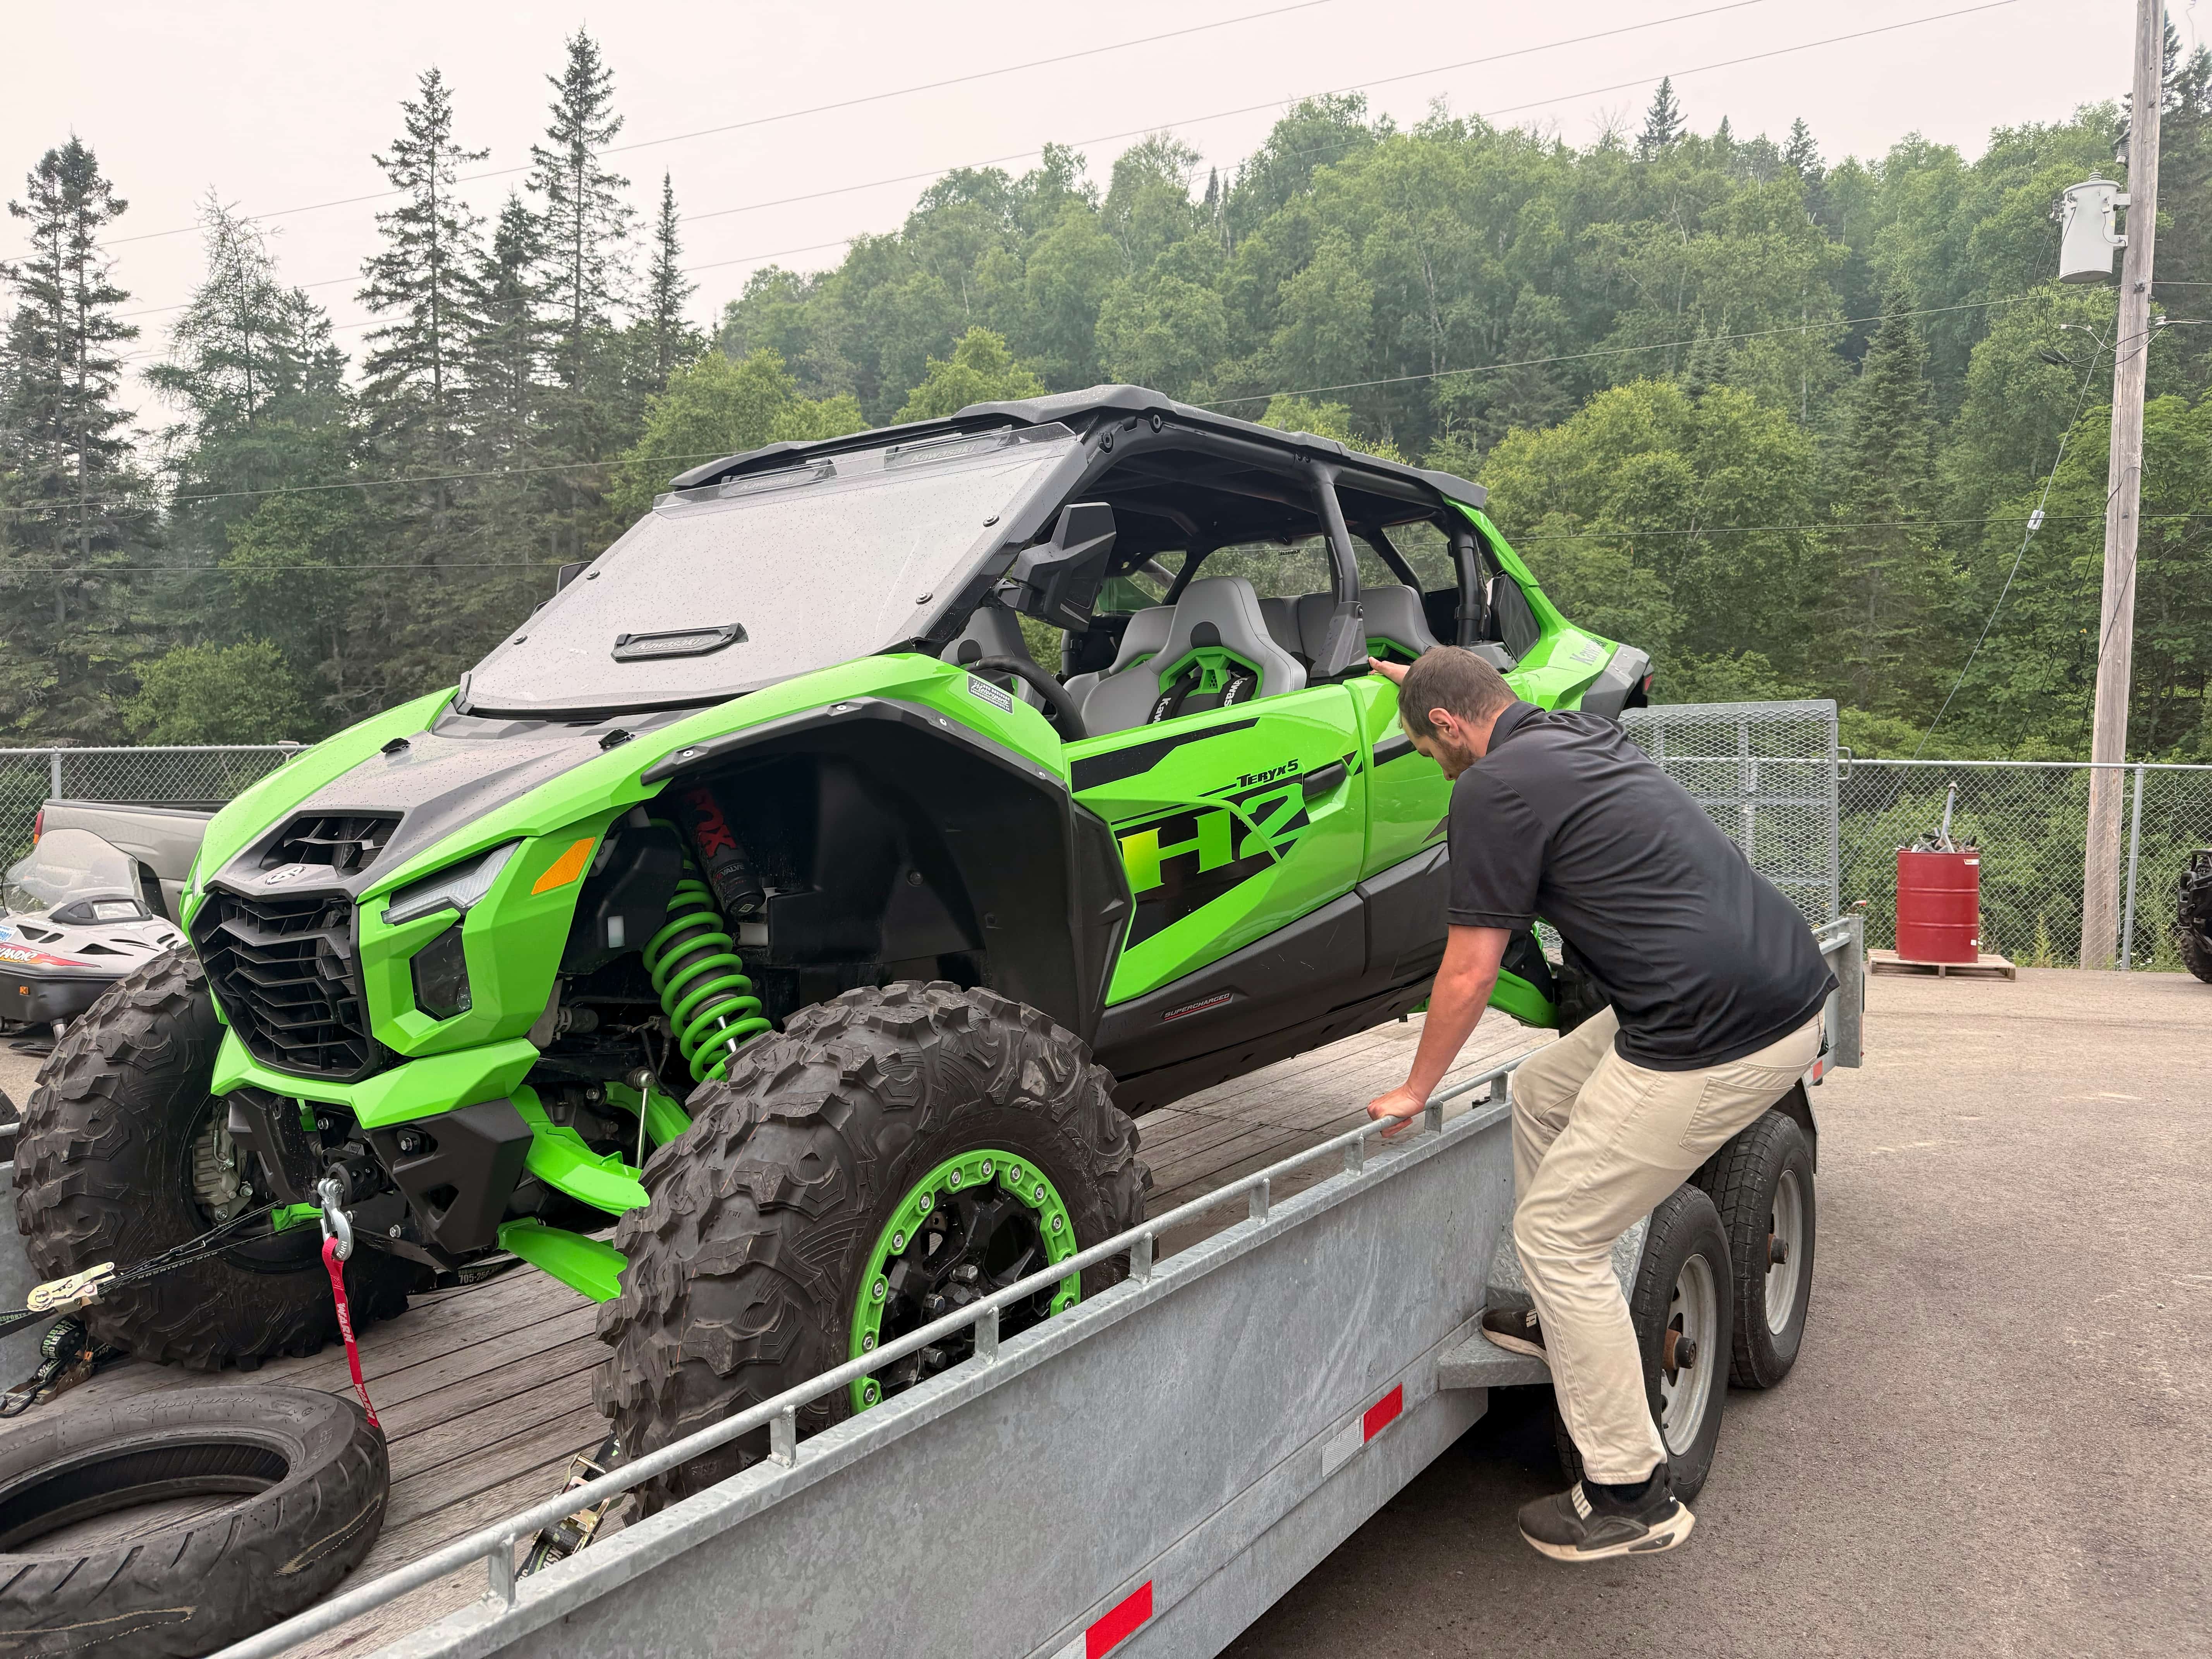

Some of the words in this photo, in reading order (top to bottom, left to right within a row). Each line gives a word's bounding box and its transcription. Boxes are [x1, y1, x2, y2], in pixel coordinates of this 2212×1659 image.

[910, 443, 979, 463] Kawasaki
[740, 474, 797, 490] Kawasaki
[635, 637, 703, 651] Kawasaki
[1117, 783, 1311, 894] H2
[1164, 993, 1230, 1018] SUPERCHARGED
[337, 1302, 354, 1343] WARN
[50, 1336, 61, 1345] LB
[354, 1383, 376, 1420] WARN
